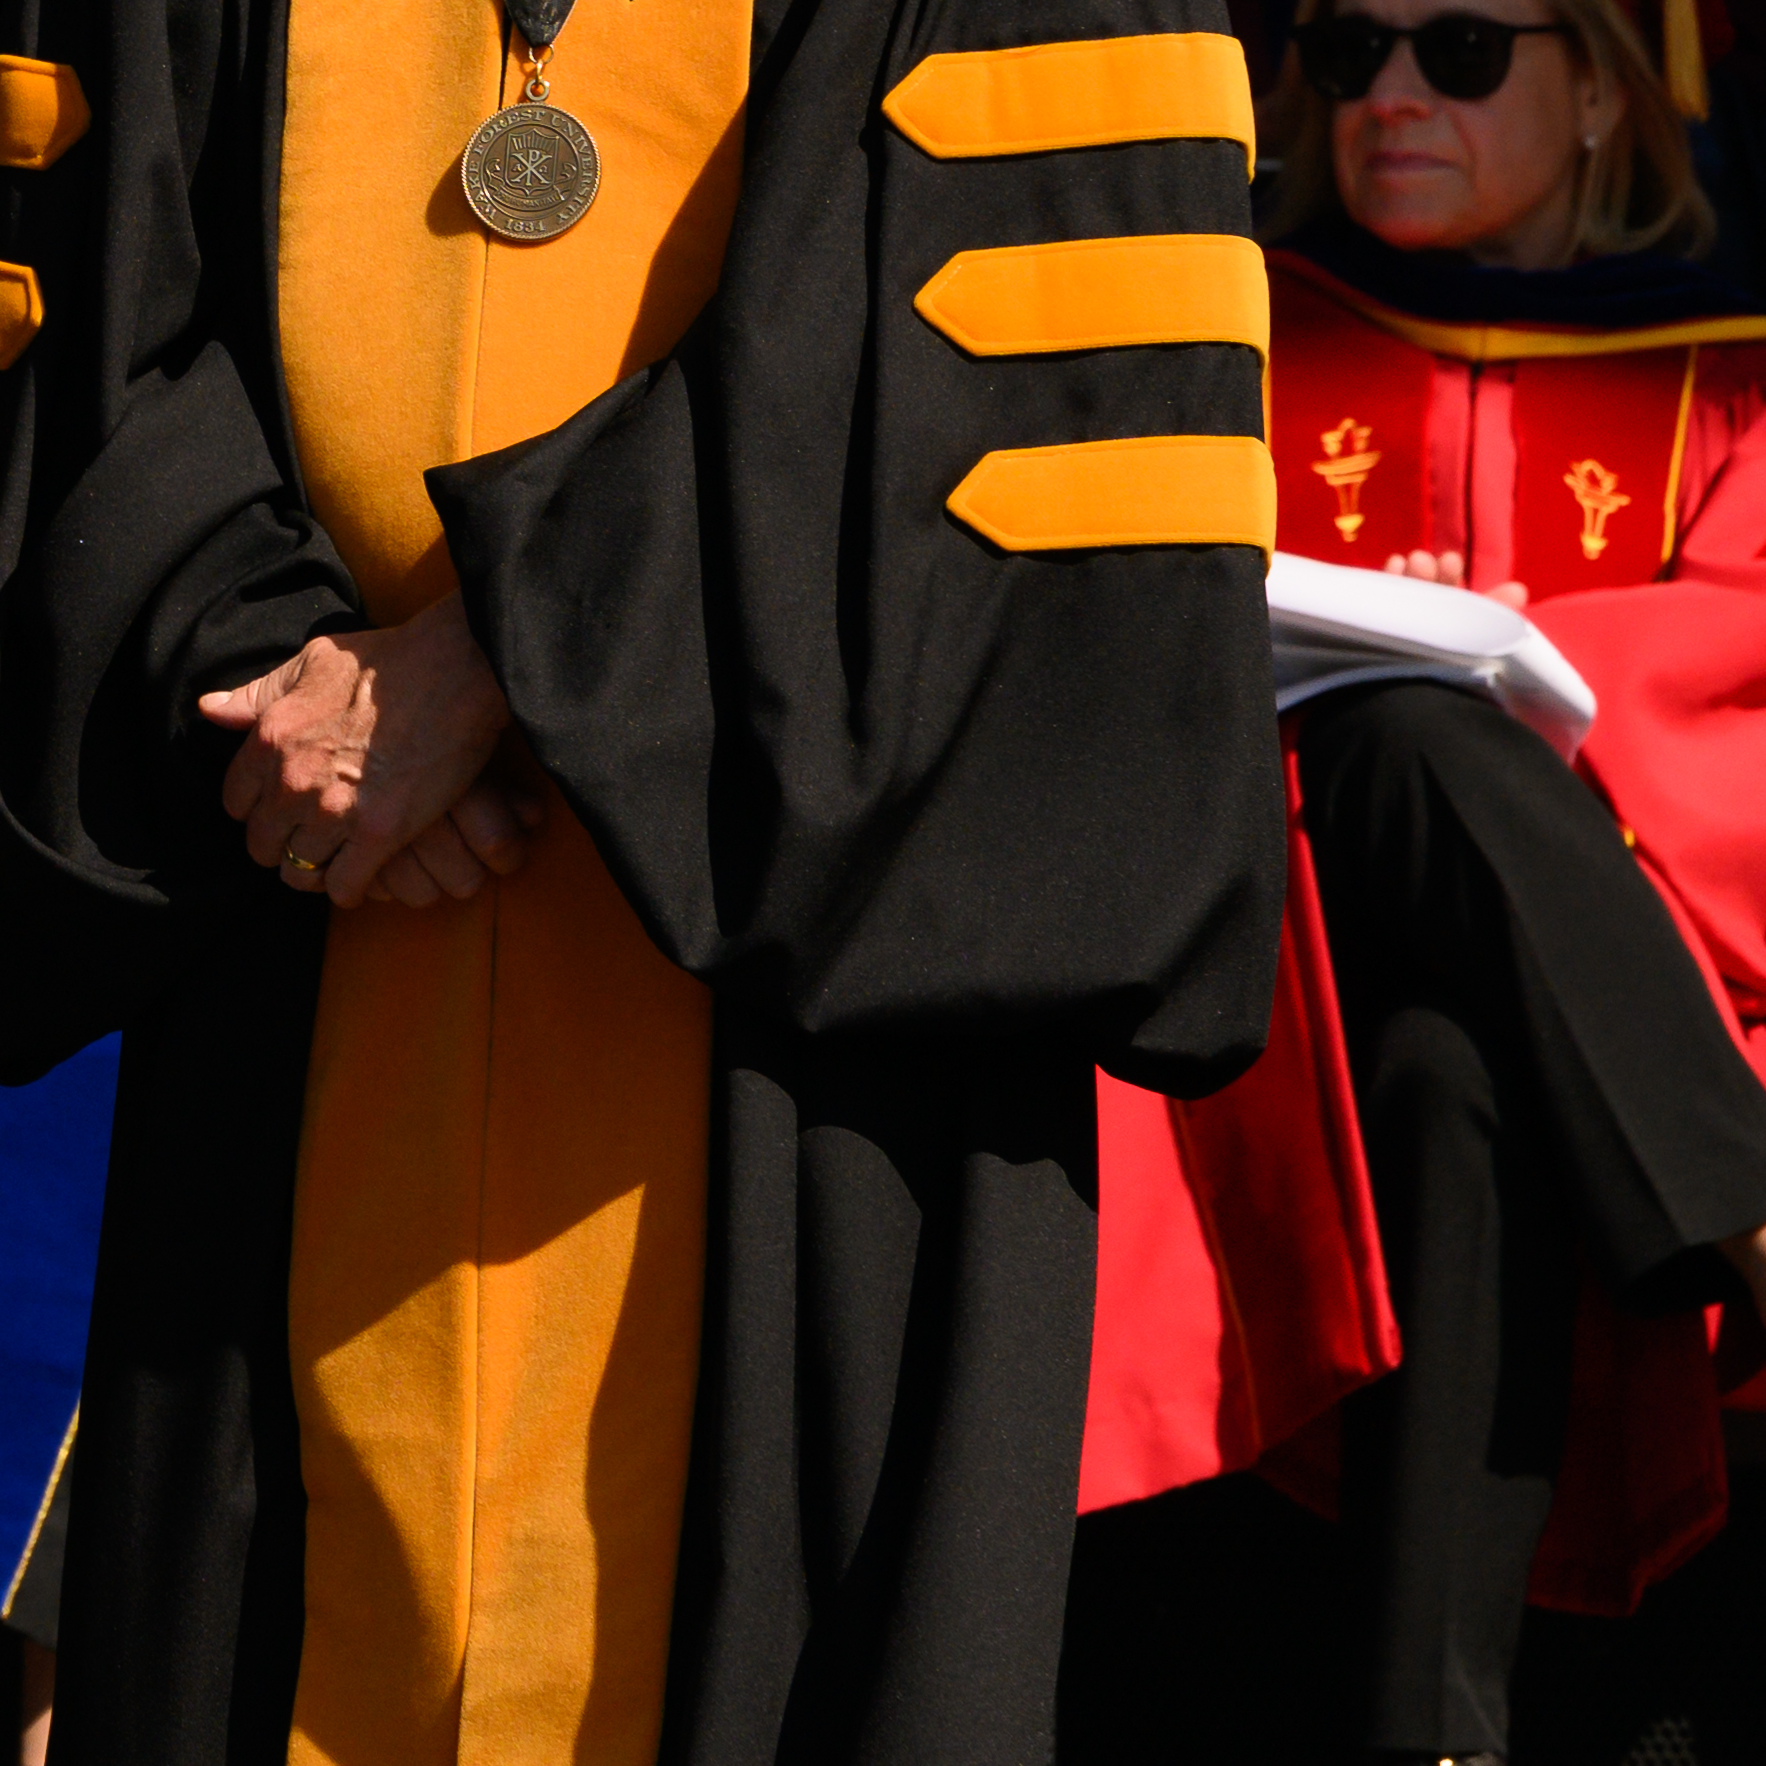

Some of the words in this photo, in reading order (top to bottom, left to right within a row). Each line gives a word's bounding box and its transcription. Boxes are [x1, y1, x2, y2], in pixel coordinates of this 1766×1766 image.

[472, 110, 546, 155] FOREST
[551, 113, 593, 223] UNIVERSITY
[505, 219, 546, 232] 1834
